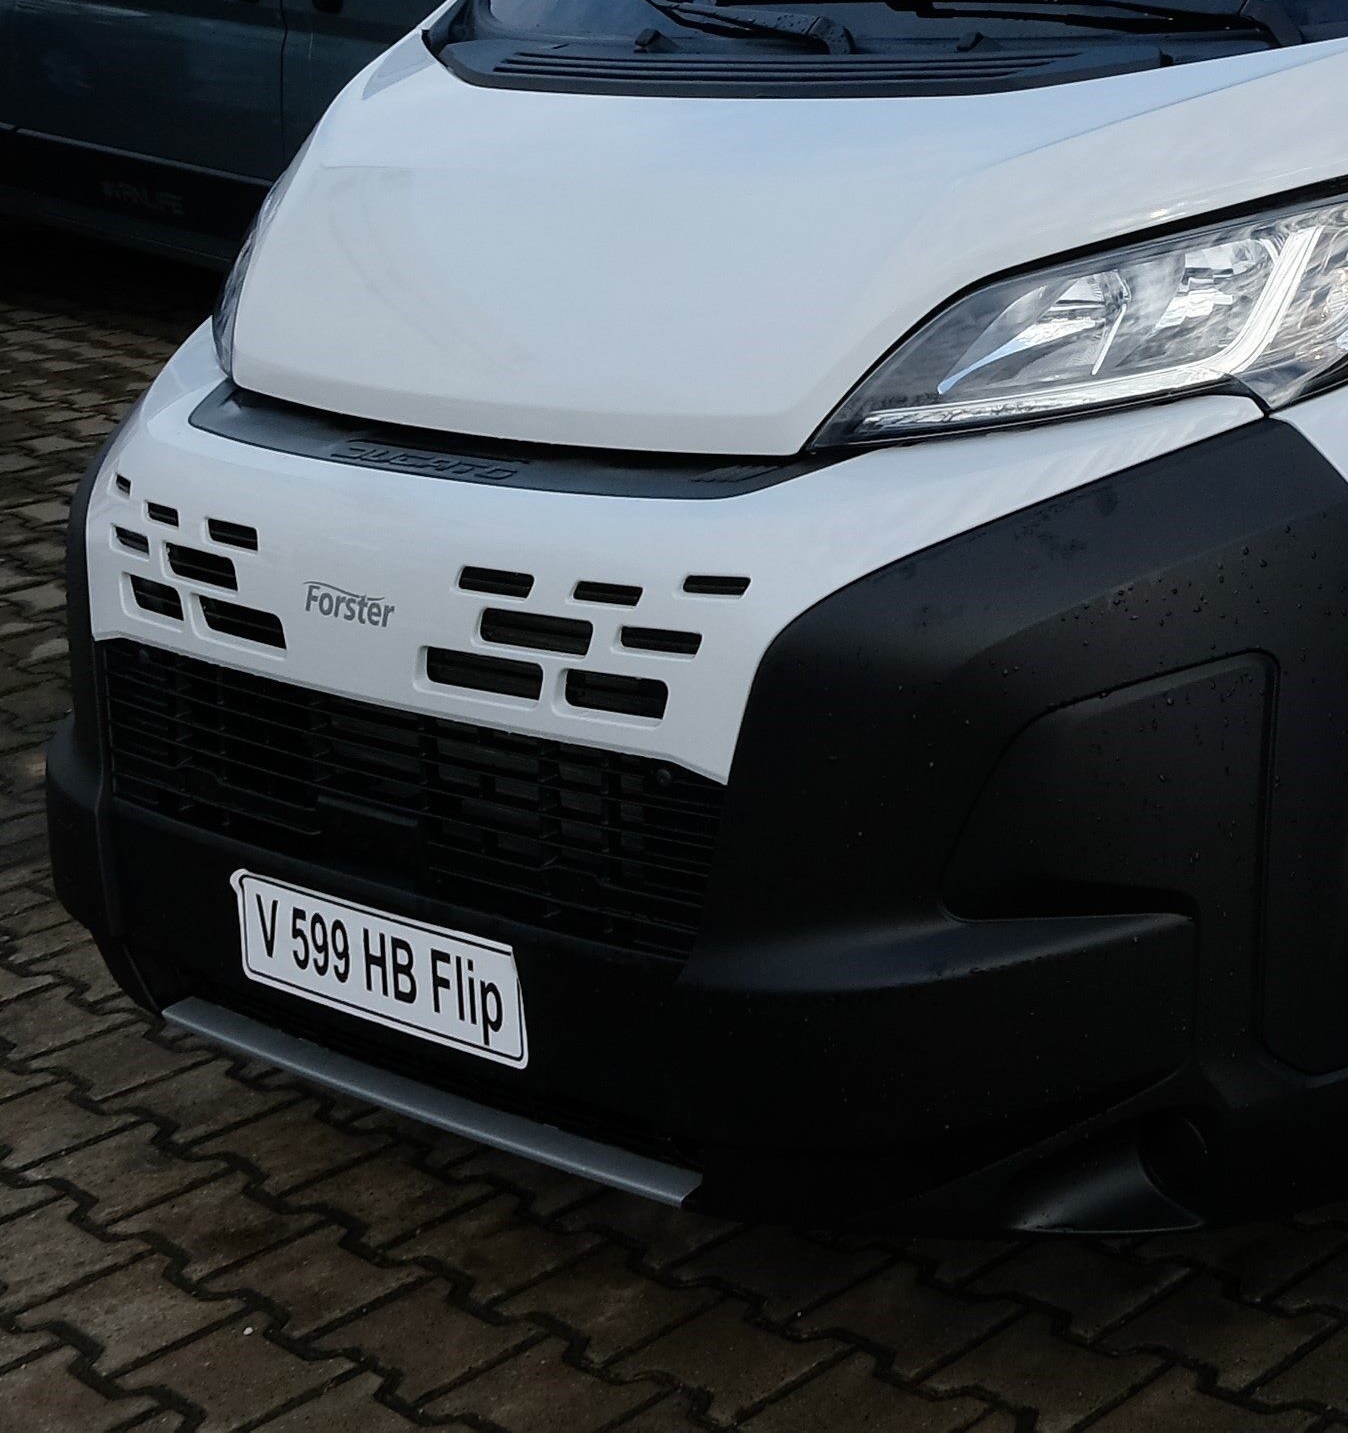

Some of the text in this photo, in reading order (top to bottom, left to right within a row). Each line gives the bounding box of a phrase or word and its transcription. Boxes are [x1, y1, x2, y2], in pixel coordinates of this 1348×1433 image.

[330, 446, 518, 480] DUCATO
[305, 584, 396, 628] Forster
[255, 893, 504, 1047] V 599 HB Flip
